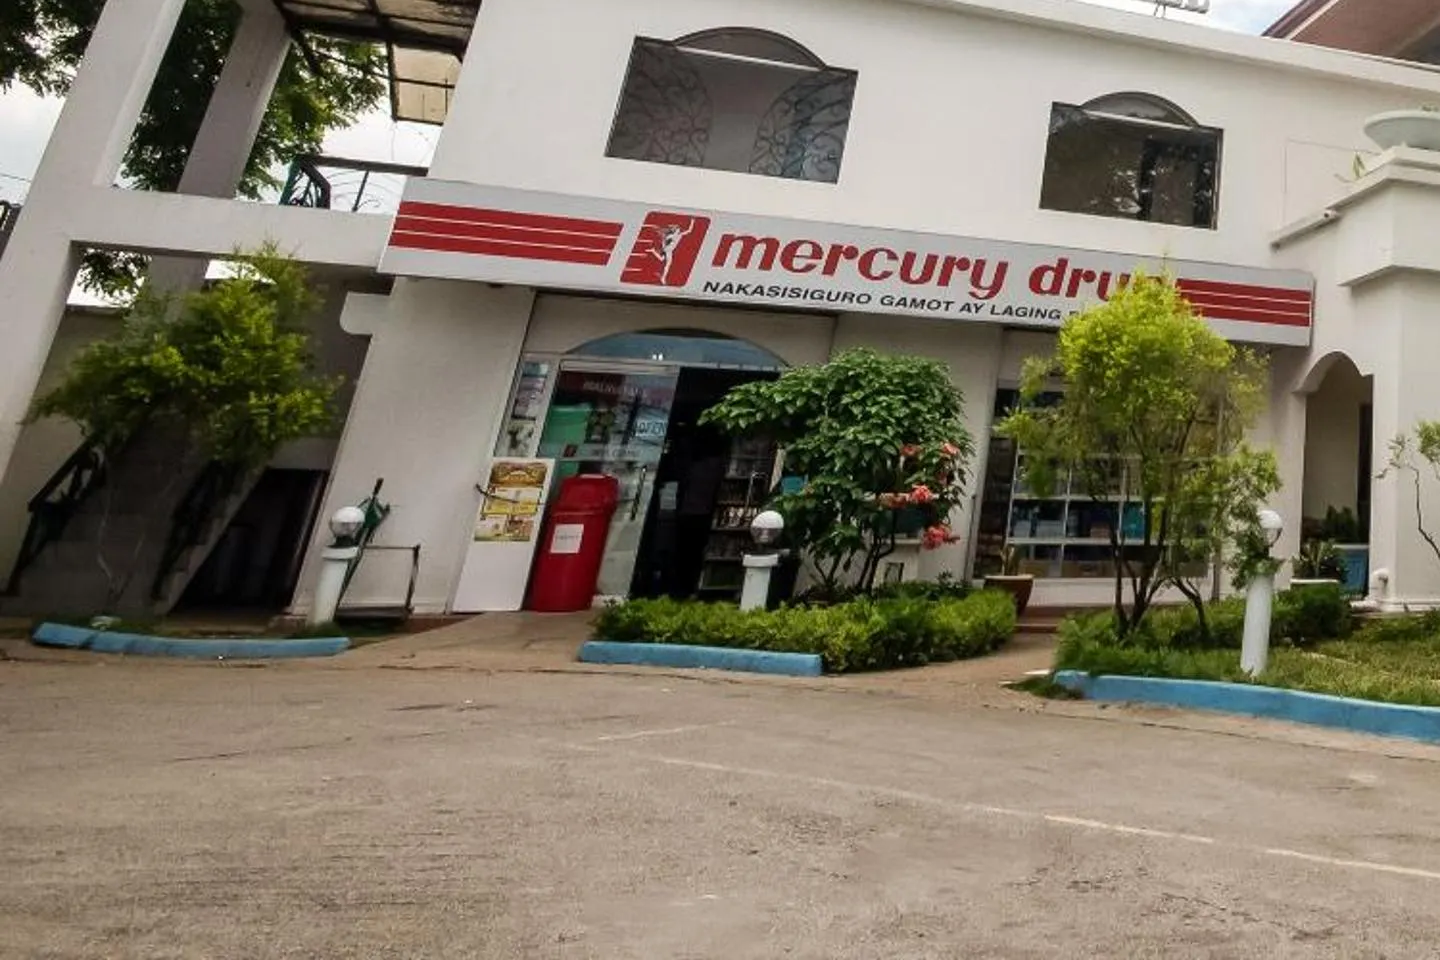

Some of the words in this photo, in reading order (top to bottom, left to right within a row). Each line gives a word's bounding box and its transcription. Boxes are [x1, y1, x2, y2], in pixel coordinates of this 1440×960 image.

[711, 233, 1009, 300] mercury
[1028, 257, 1166, 306] dru
[703, 280, 872, 305] NAKASISIGURO
[880, 295, 954, 312] GAMOT
[959, 302, 986, 314] AY
[990, 304, 1062, 320] LAGING
